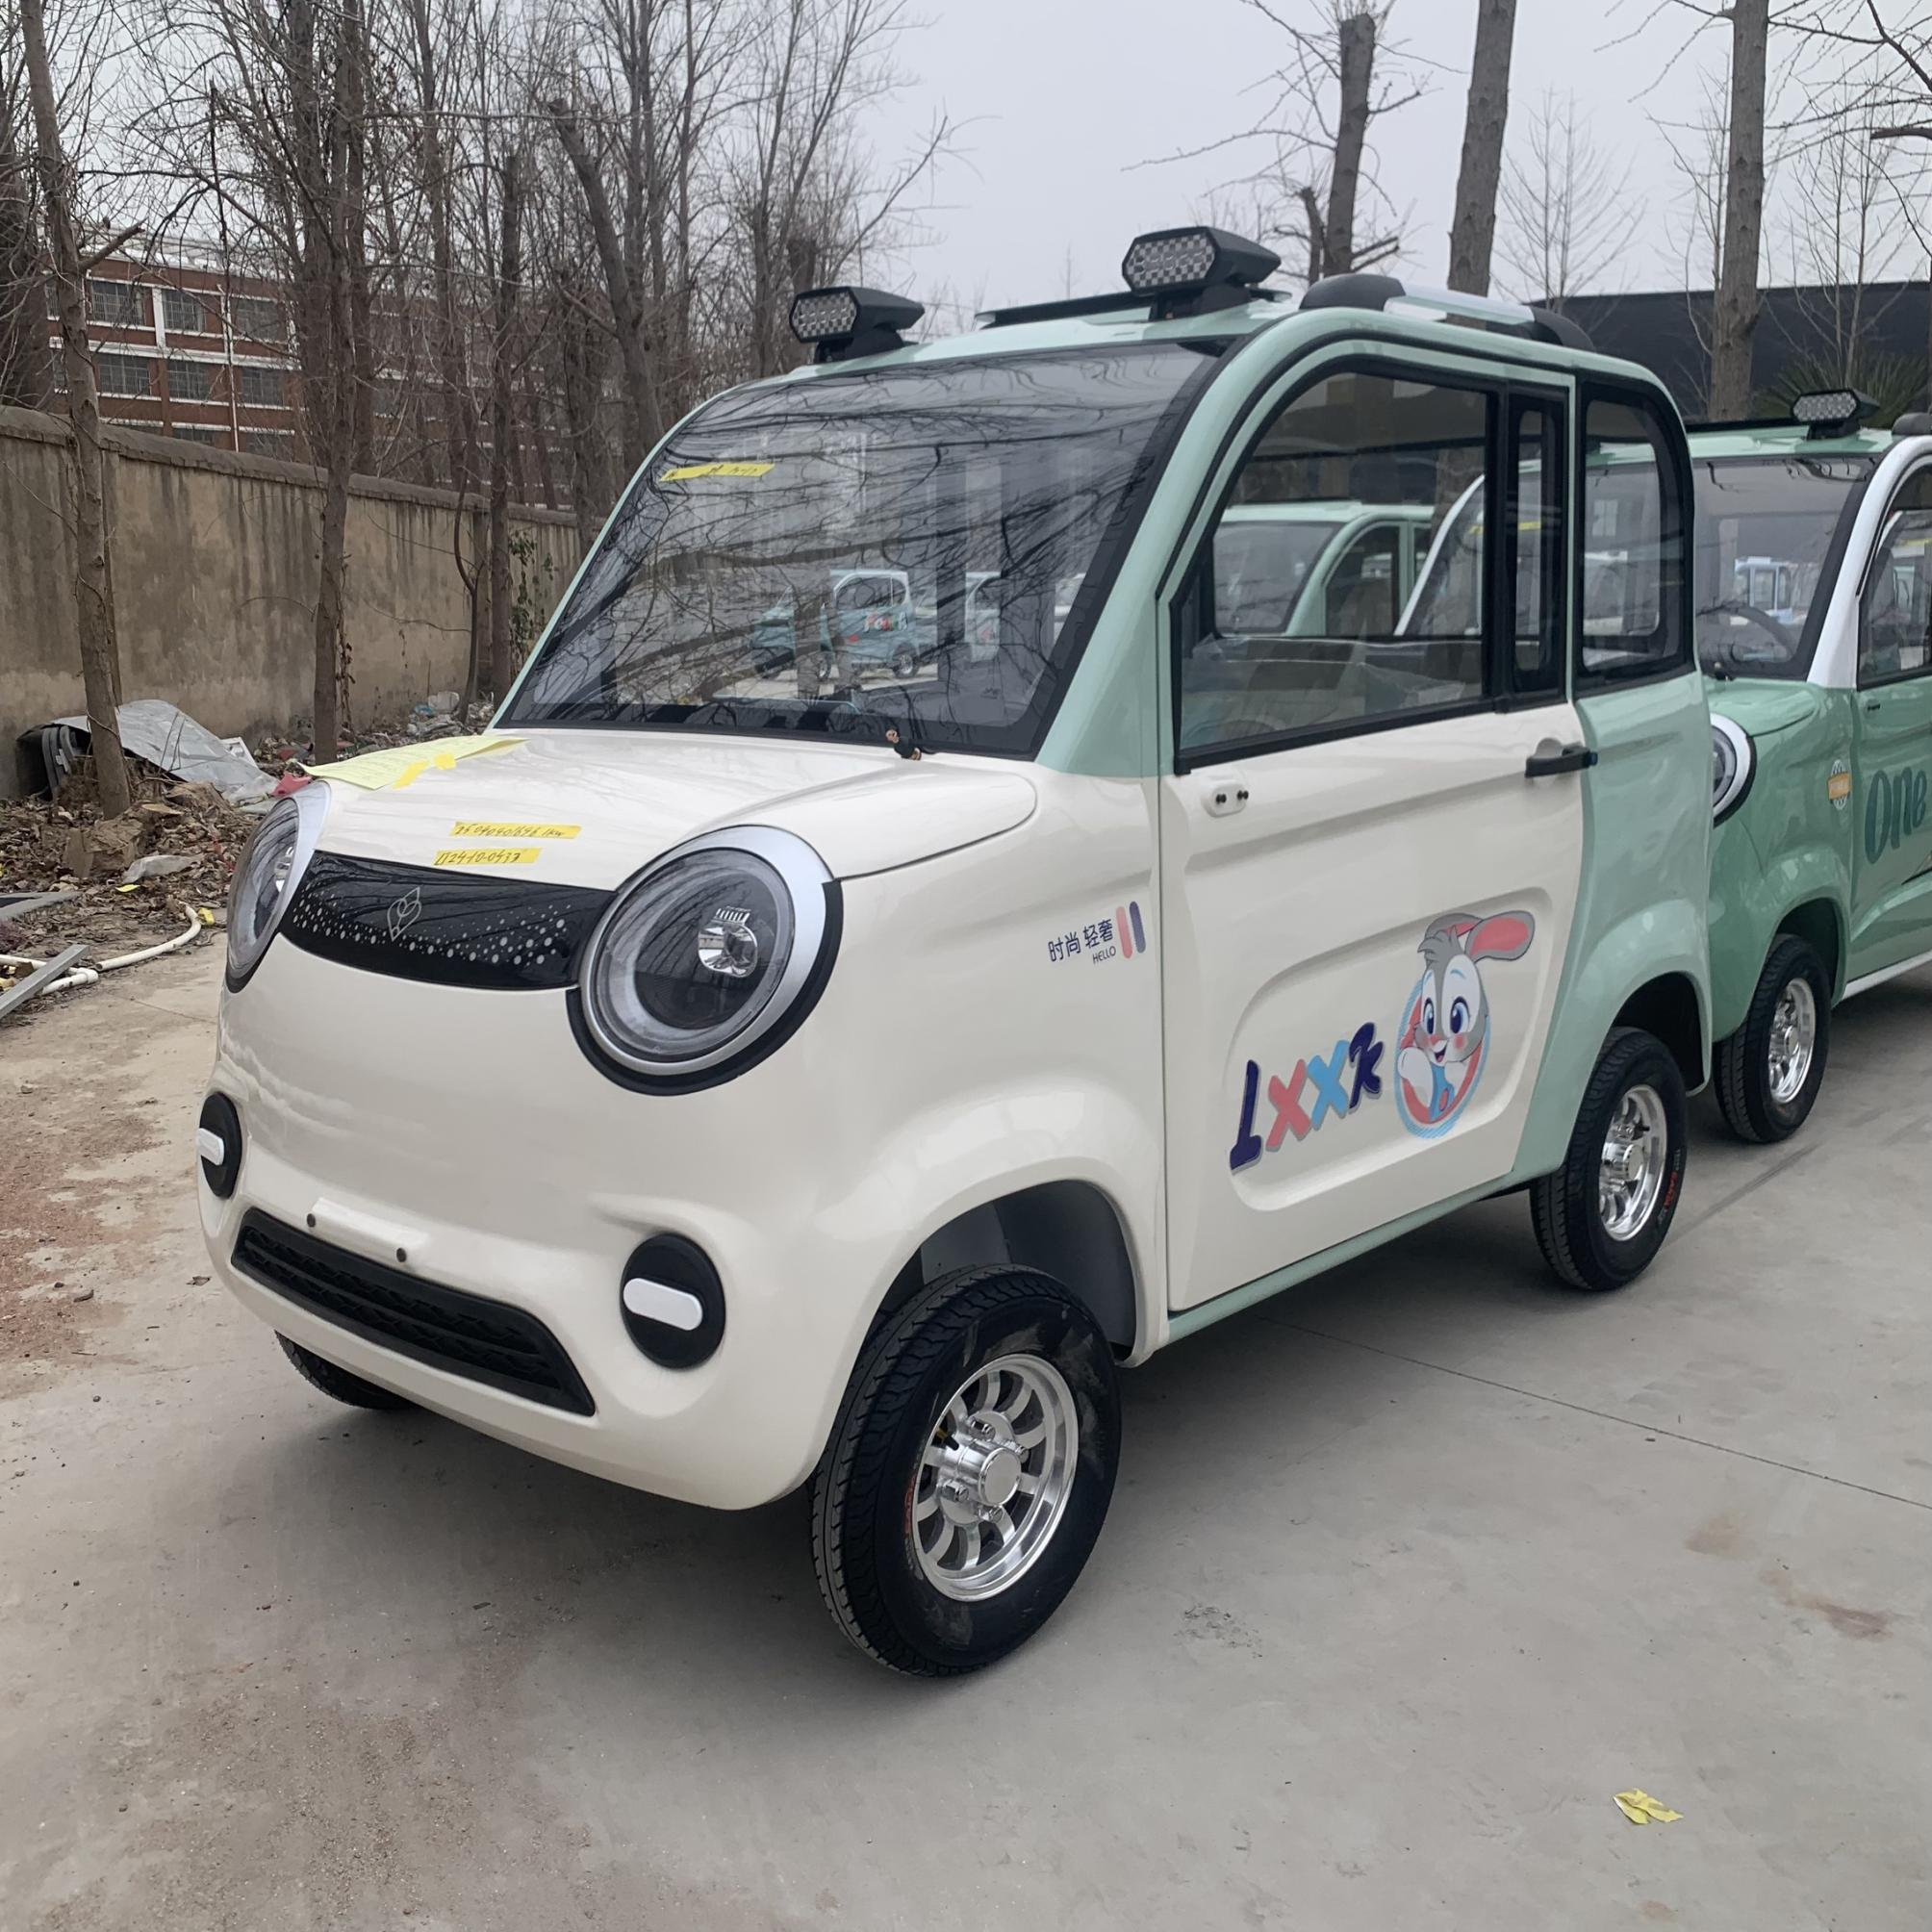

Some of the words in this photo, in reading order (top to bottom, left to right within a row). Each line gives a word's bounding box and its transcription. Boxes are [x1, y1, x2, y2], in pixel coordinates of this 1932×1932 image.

[1048, 931, 1081, 962] 时尚
[1082, 918, 1113, 949] 轻奢
[1092, 945, 1117, 965] HELLO
